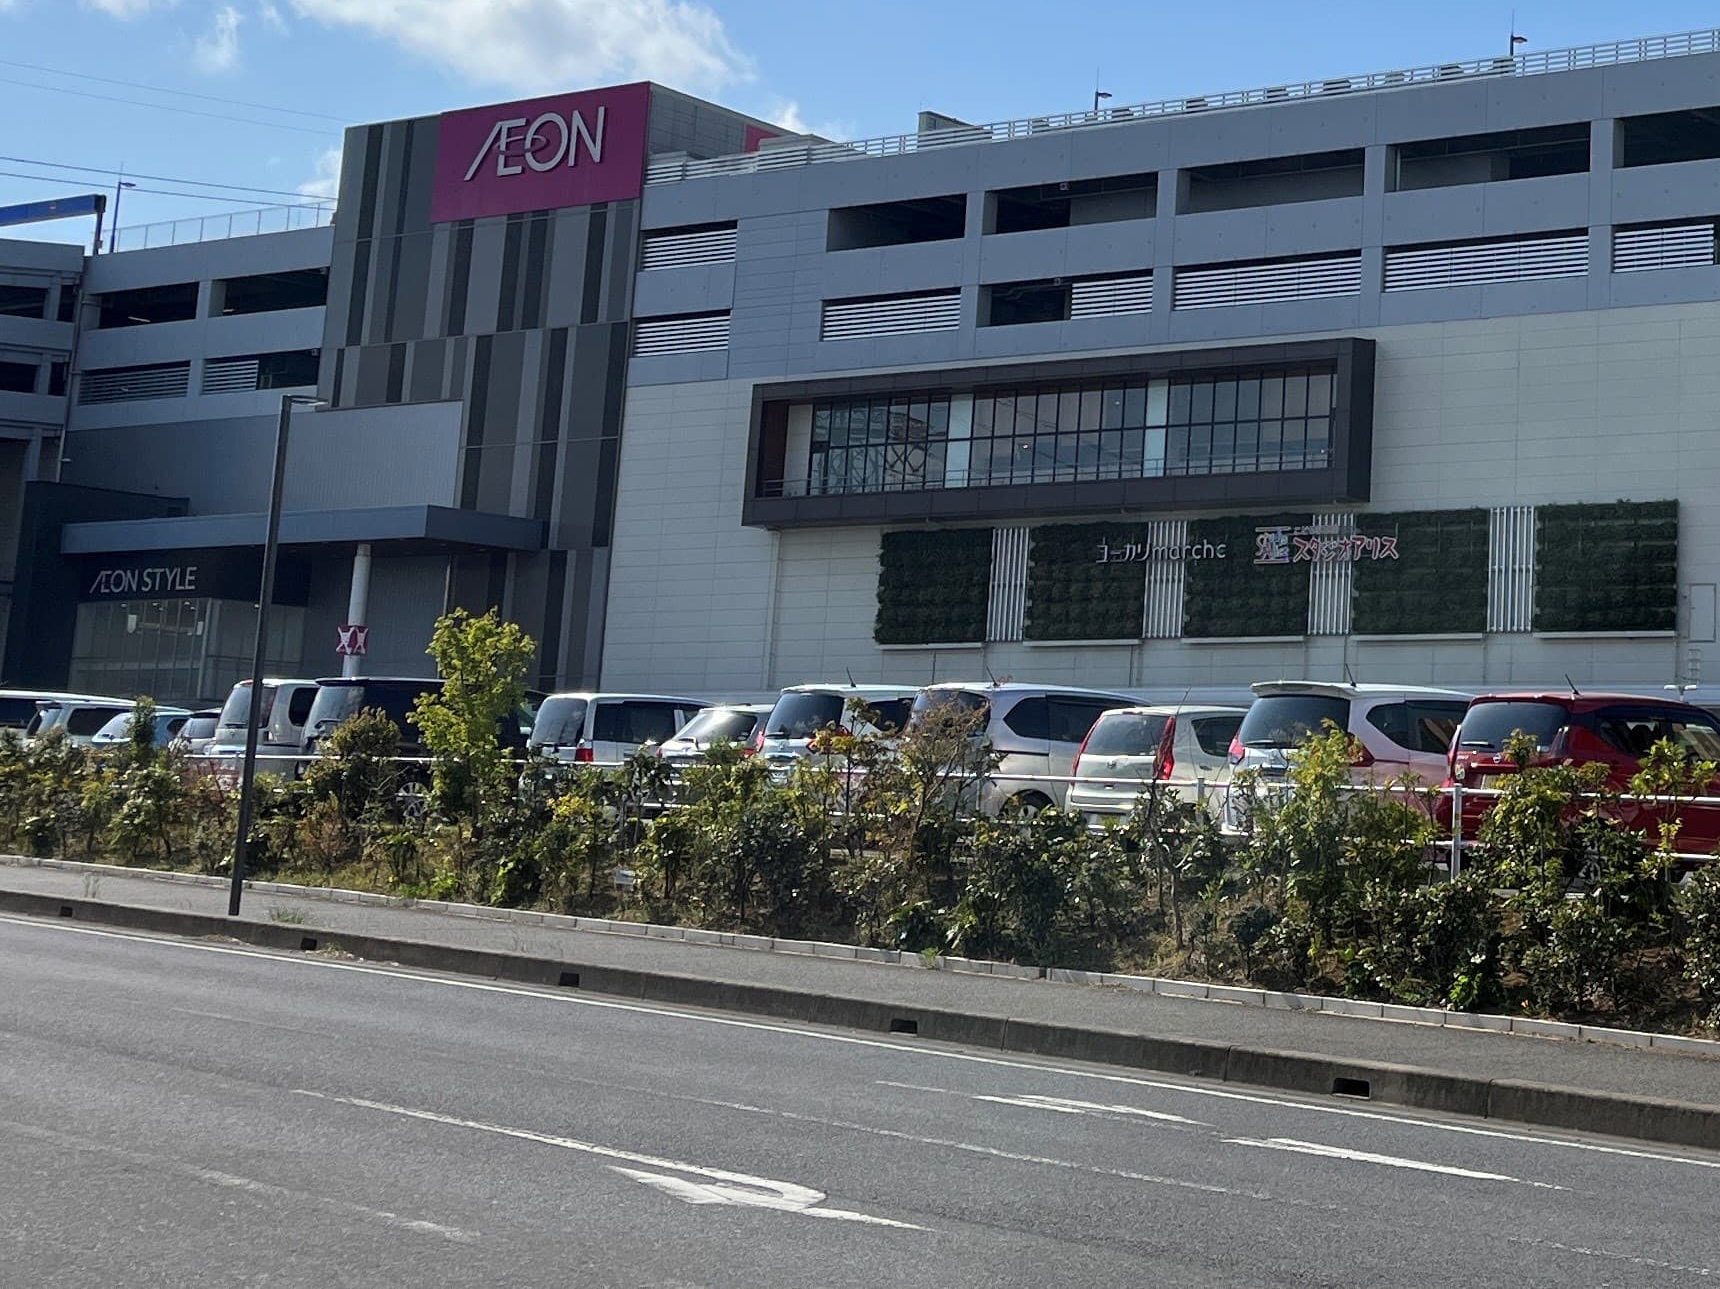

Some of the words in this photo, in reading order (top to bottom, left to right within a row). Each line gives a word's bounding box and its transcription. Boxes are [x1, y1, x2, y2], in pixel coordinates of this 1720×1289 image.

[1293, 534, 1399, 563] スタジオアリス
[141, 566, 198, 592] STYLE
